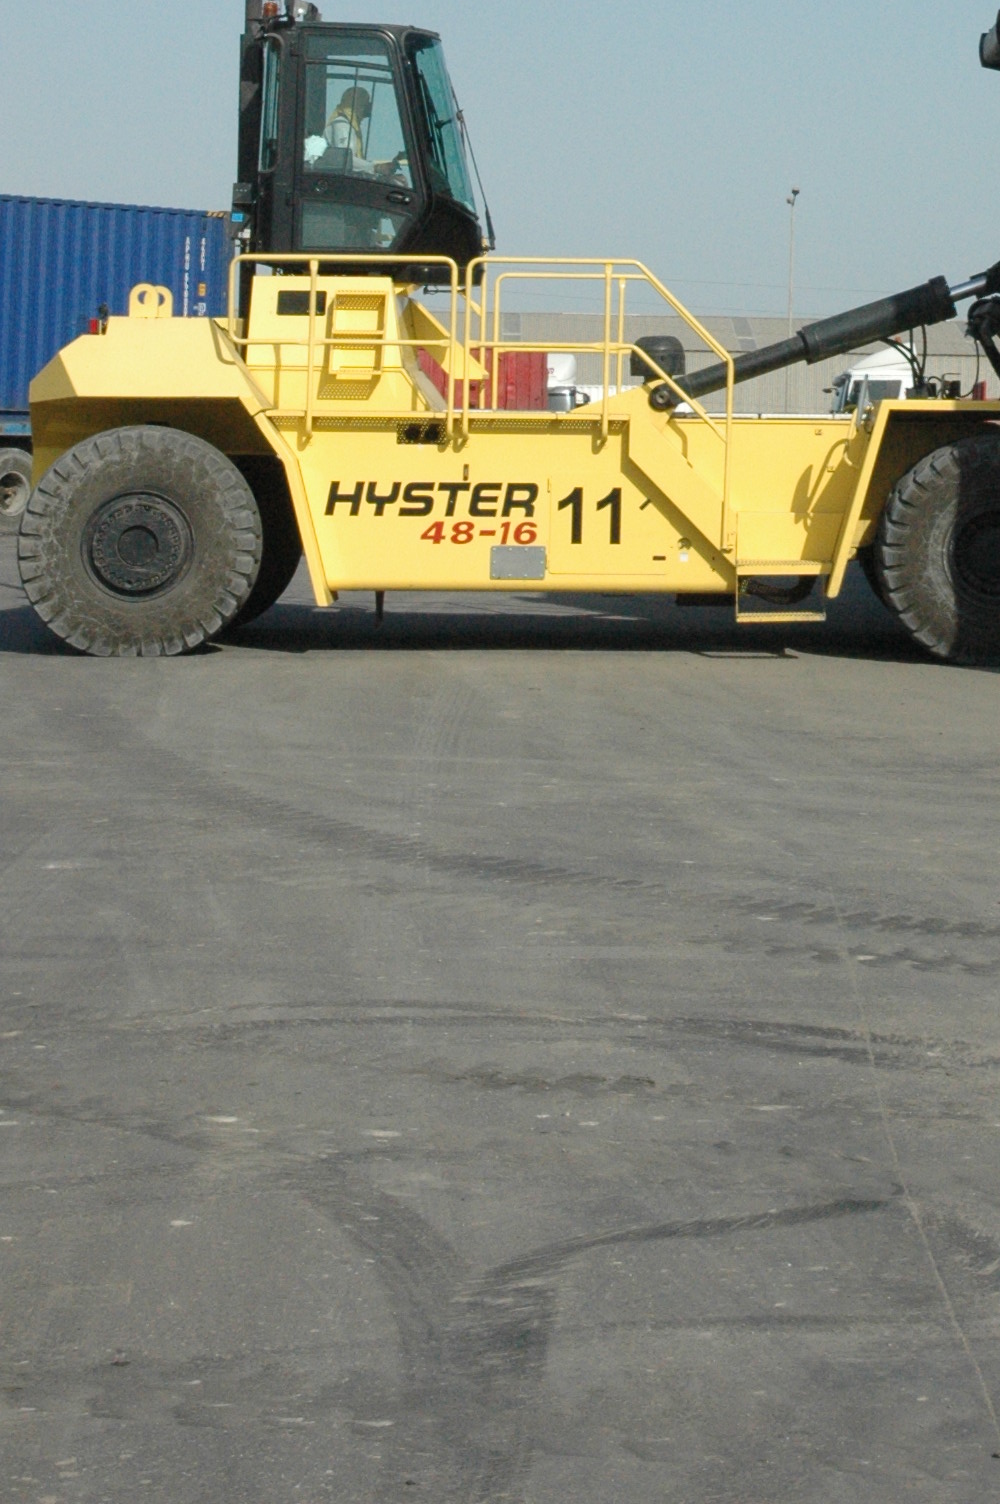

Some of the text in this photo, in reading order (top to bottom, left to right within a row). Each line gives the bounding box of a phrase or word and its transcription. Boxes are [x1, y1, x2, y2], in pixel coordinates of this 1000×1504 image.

[325, 481, 539, 517] HYSTER
[558, 487, 621, 544] 11
[420, 521, 538, 545] 48-16
